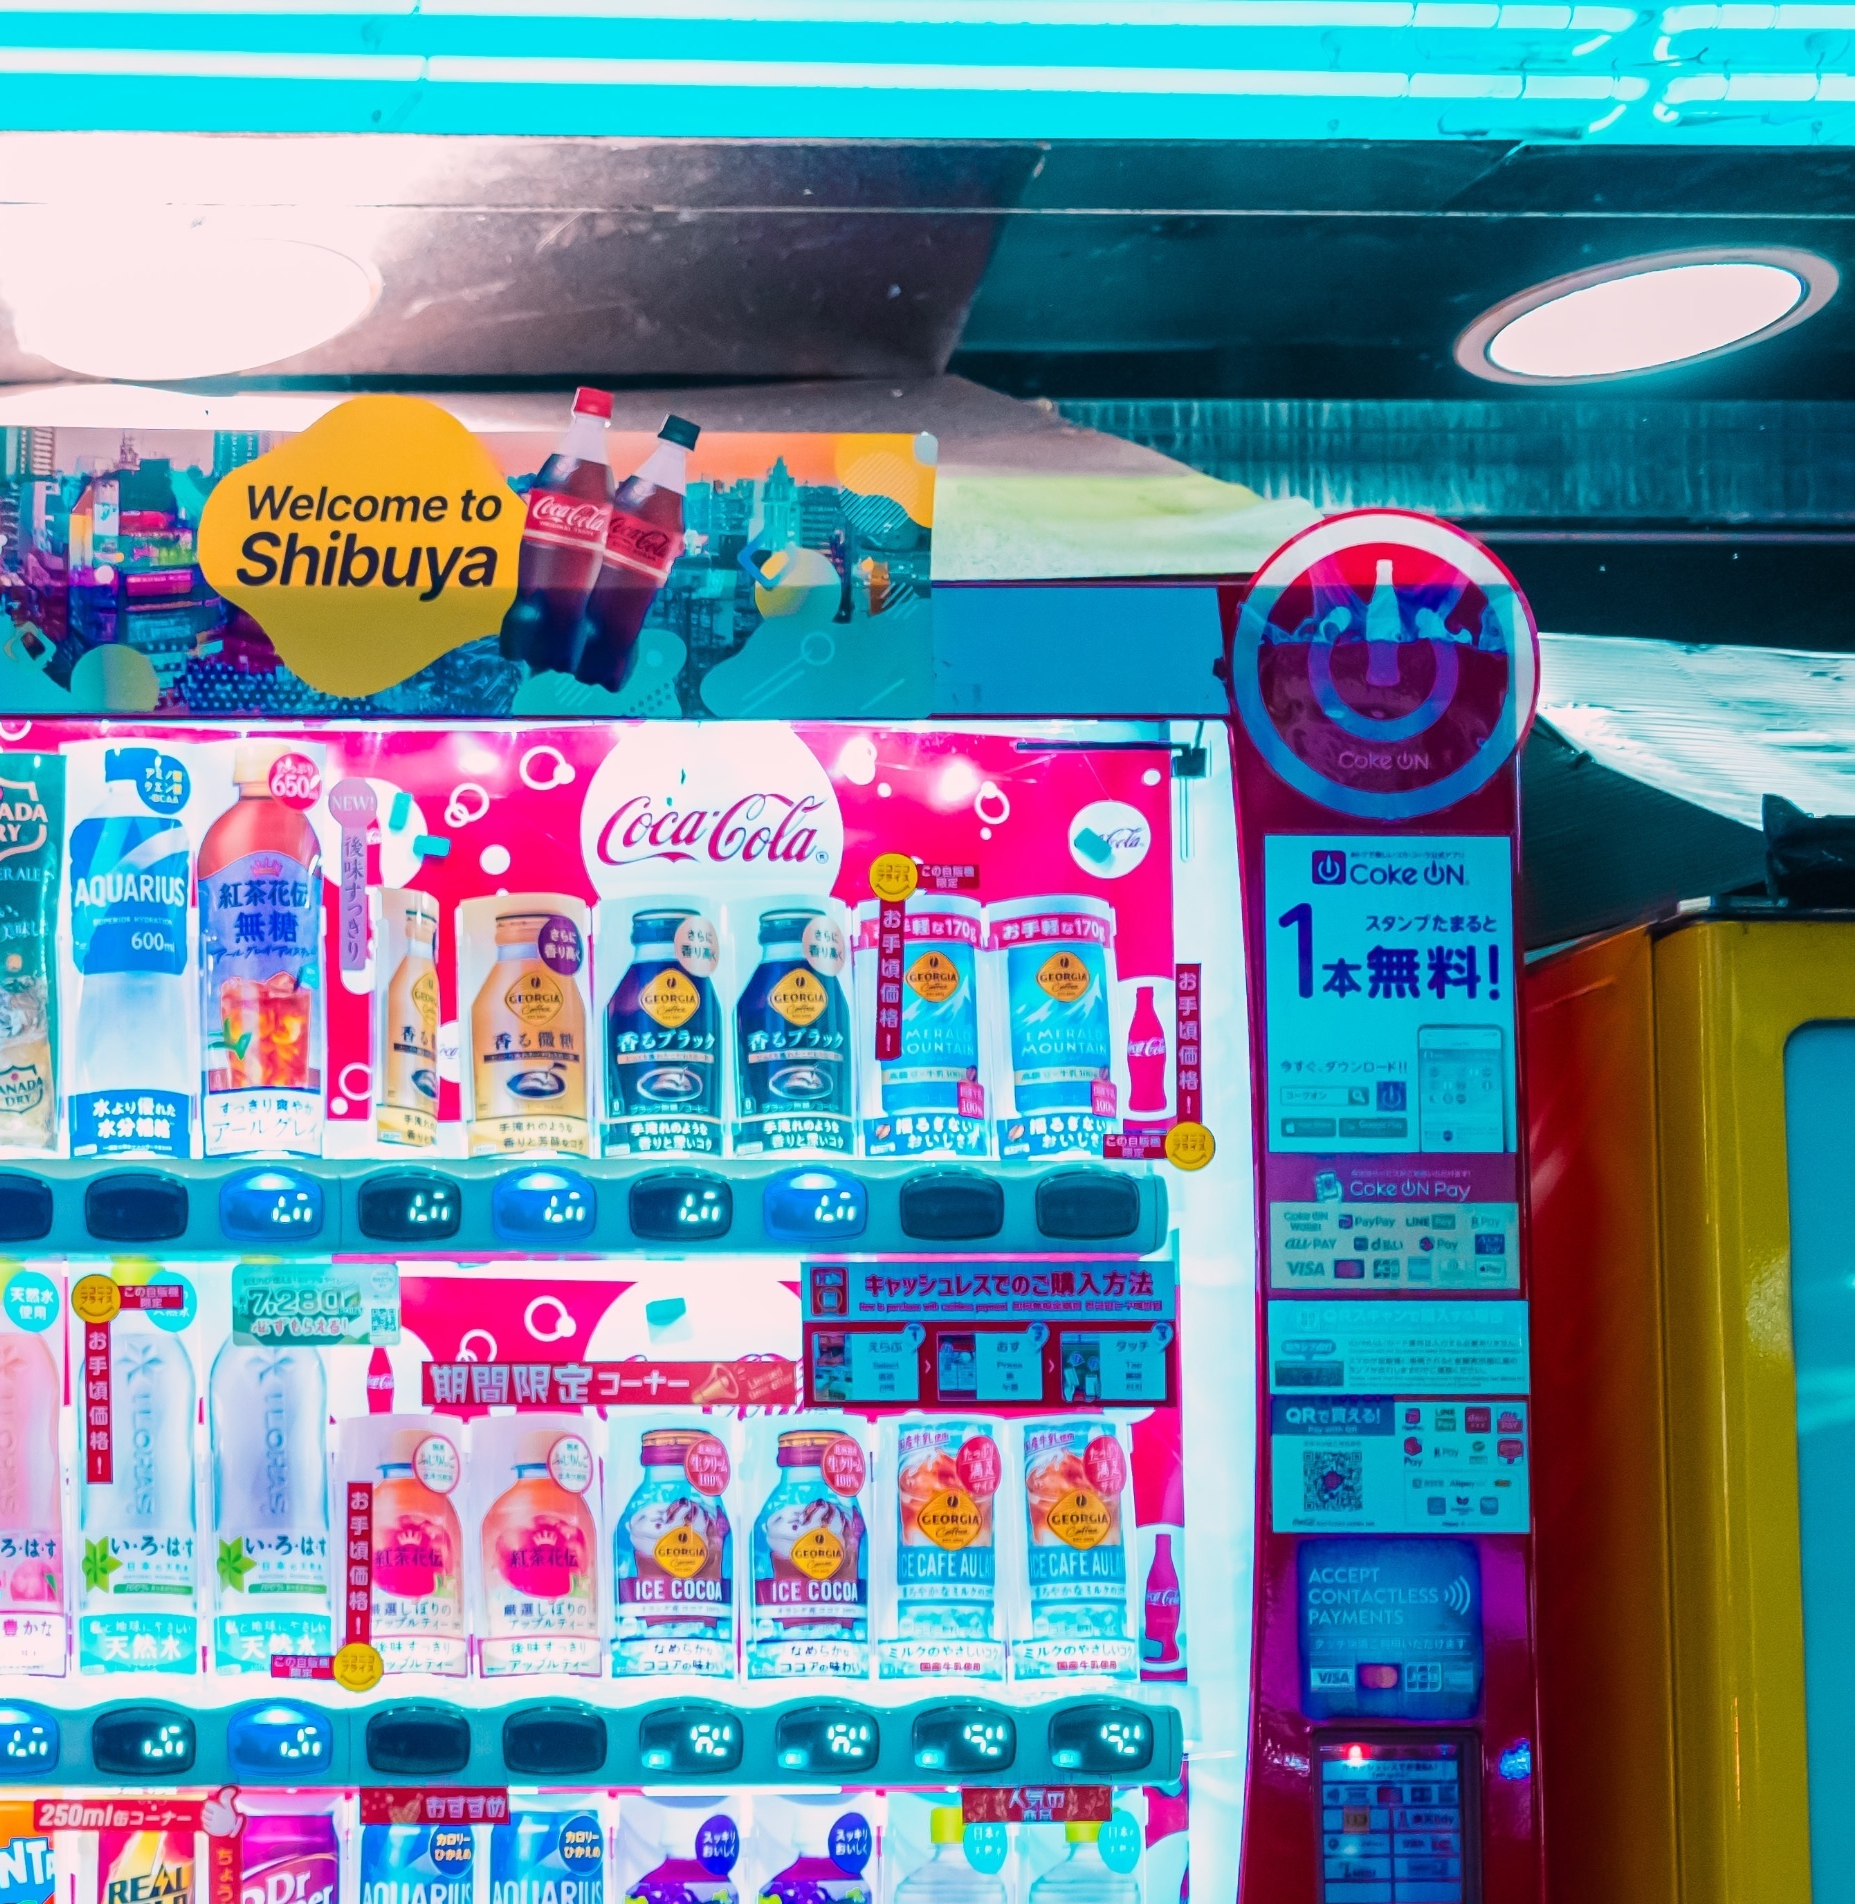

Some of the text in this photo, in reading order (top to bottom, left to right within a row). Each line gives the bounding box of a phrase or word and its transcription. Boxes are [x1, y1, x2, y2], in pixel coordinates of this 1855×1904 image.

[244, 484, 502, 526] Welcome to
[236, 532, 500, 602] Shibuya
[1338, 750, 1392, 770] Coke
[596, 792, 828, 867] Coca-Cola
[1350, 863, 1418, 886] Coke
[76, 876, 186, 906] AQUARIUS
[218, 880, 310, 910] 紅茶花伝
[234, 911, 300, 943] 無糖
[1365, 914, 1498, 933] スタンプたまると
[1278, 902, 1501, 1001] 1本無料!
[509, 994, 562, 1006] GEORGIA
[646, 992, 700, 1006] GEORGIA
[773, 992, 828, 1006] GEORGIA
[1349, 1180, 1397, 1199] Coke
[1434, 1181, 1472, 1203] Pay
[865, 1270, 1154, 1297] キャッシュレスでのご購入方法
[430, 1364, 690, 1402] 期間限定コーナー
[921, 1513, 983, 1527] GEORGIA
[1051, 1513, 1112, 1527] GEORGIA
[1308, 1567, 1380, 1585] ACCEPT
[634, 1578, 723, 1602] ICE COCOA
[771, 1578, 858, 1603] ICE COCOA
[1308, 1588, 1439, 1605] CONTACTLESS
[1308, 1609, 1404, 1626] PAYMENTS
[1317, 1671, 1350, 1684] VISA
[261, 1869, 312, 1902] Dr
